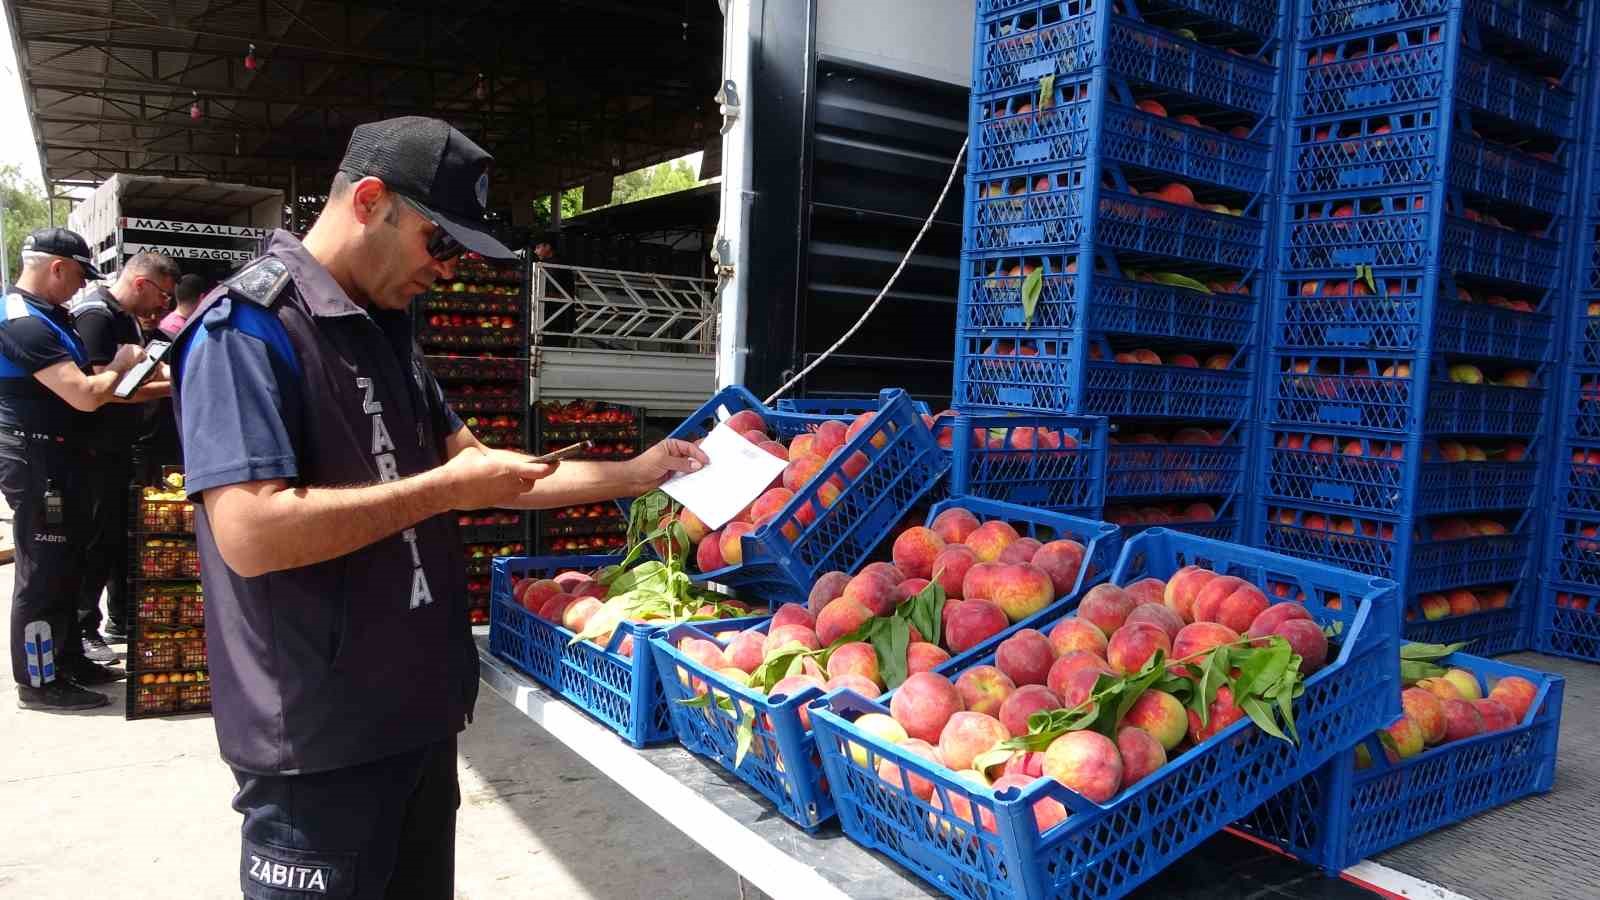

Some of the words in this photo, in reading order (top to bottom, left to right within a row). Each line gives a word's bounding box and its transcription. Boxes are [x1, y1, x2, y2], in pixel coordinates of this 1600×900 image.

[13, 430, 49, 440] ZAITA
[356, 377, 433, 610] ZABTA
[249, 855, 325, 890] ZABITA
